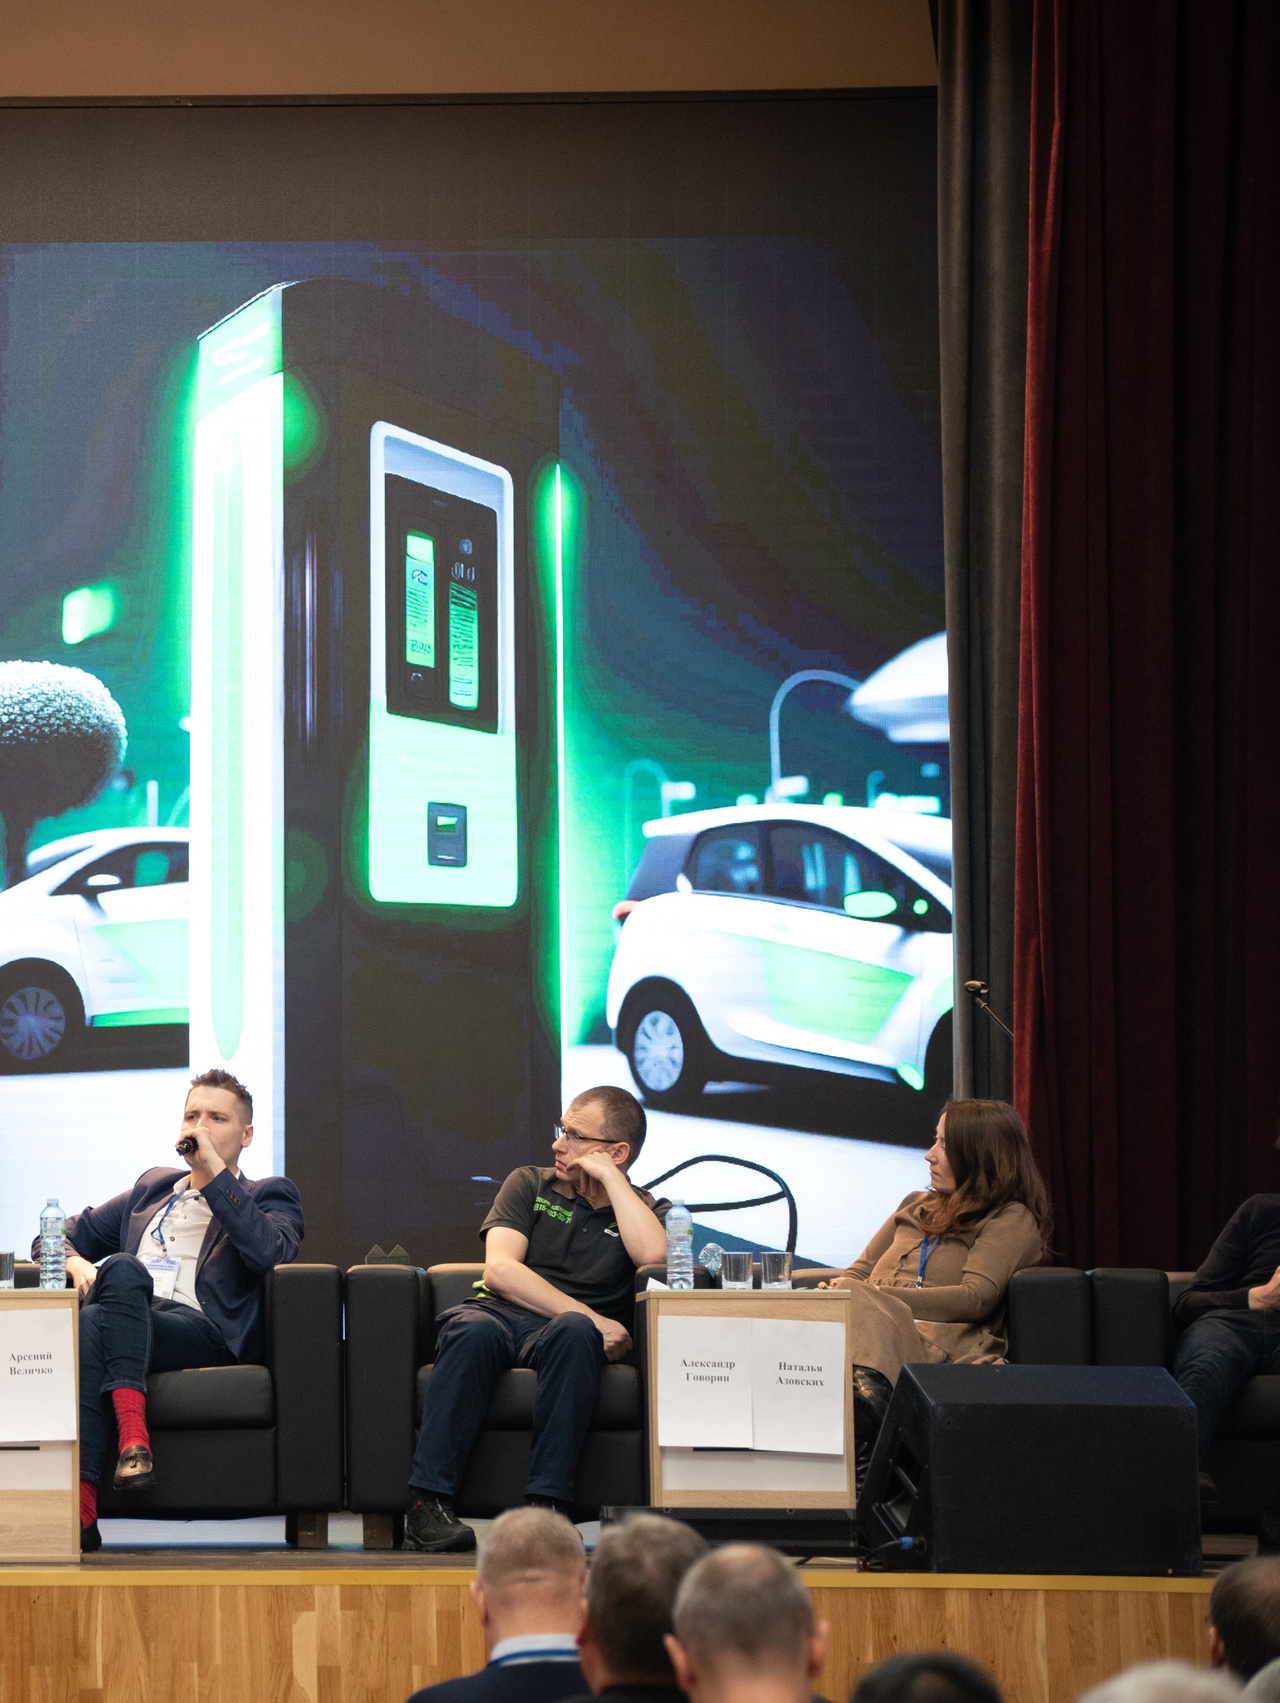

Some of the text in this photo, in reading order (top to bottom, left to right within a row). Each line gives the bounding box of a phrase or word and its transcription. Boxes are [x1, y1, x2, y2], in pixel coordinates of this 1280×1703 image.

[9, 1352, 53, 1362] Арсений
[680, 1359, 736, 1370] Александр
[778, 1361, 823, 1373] Наталья
[9, 1366, 53, 1376] Величко
[686, 1372, 730, 1383] Говорин
[776, 1376, 825, 1387] Азовских
